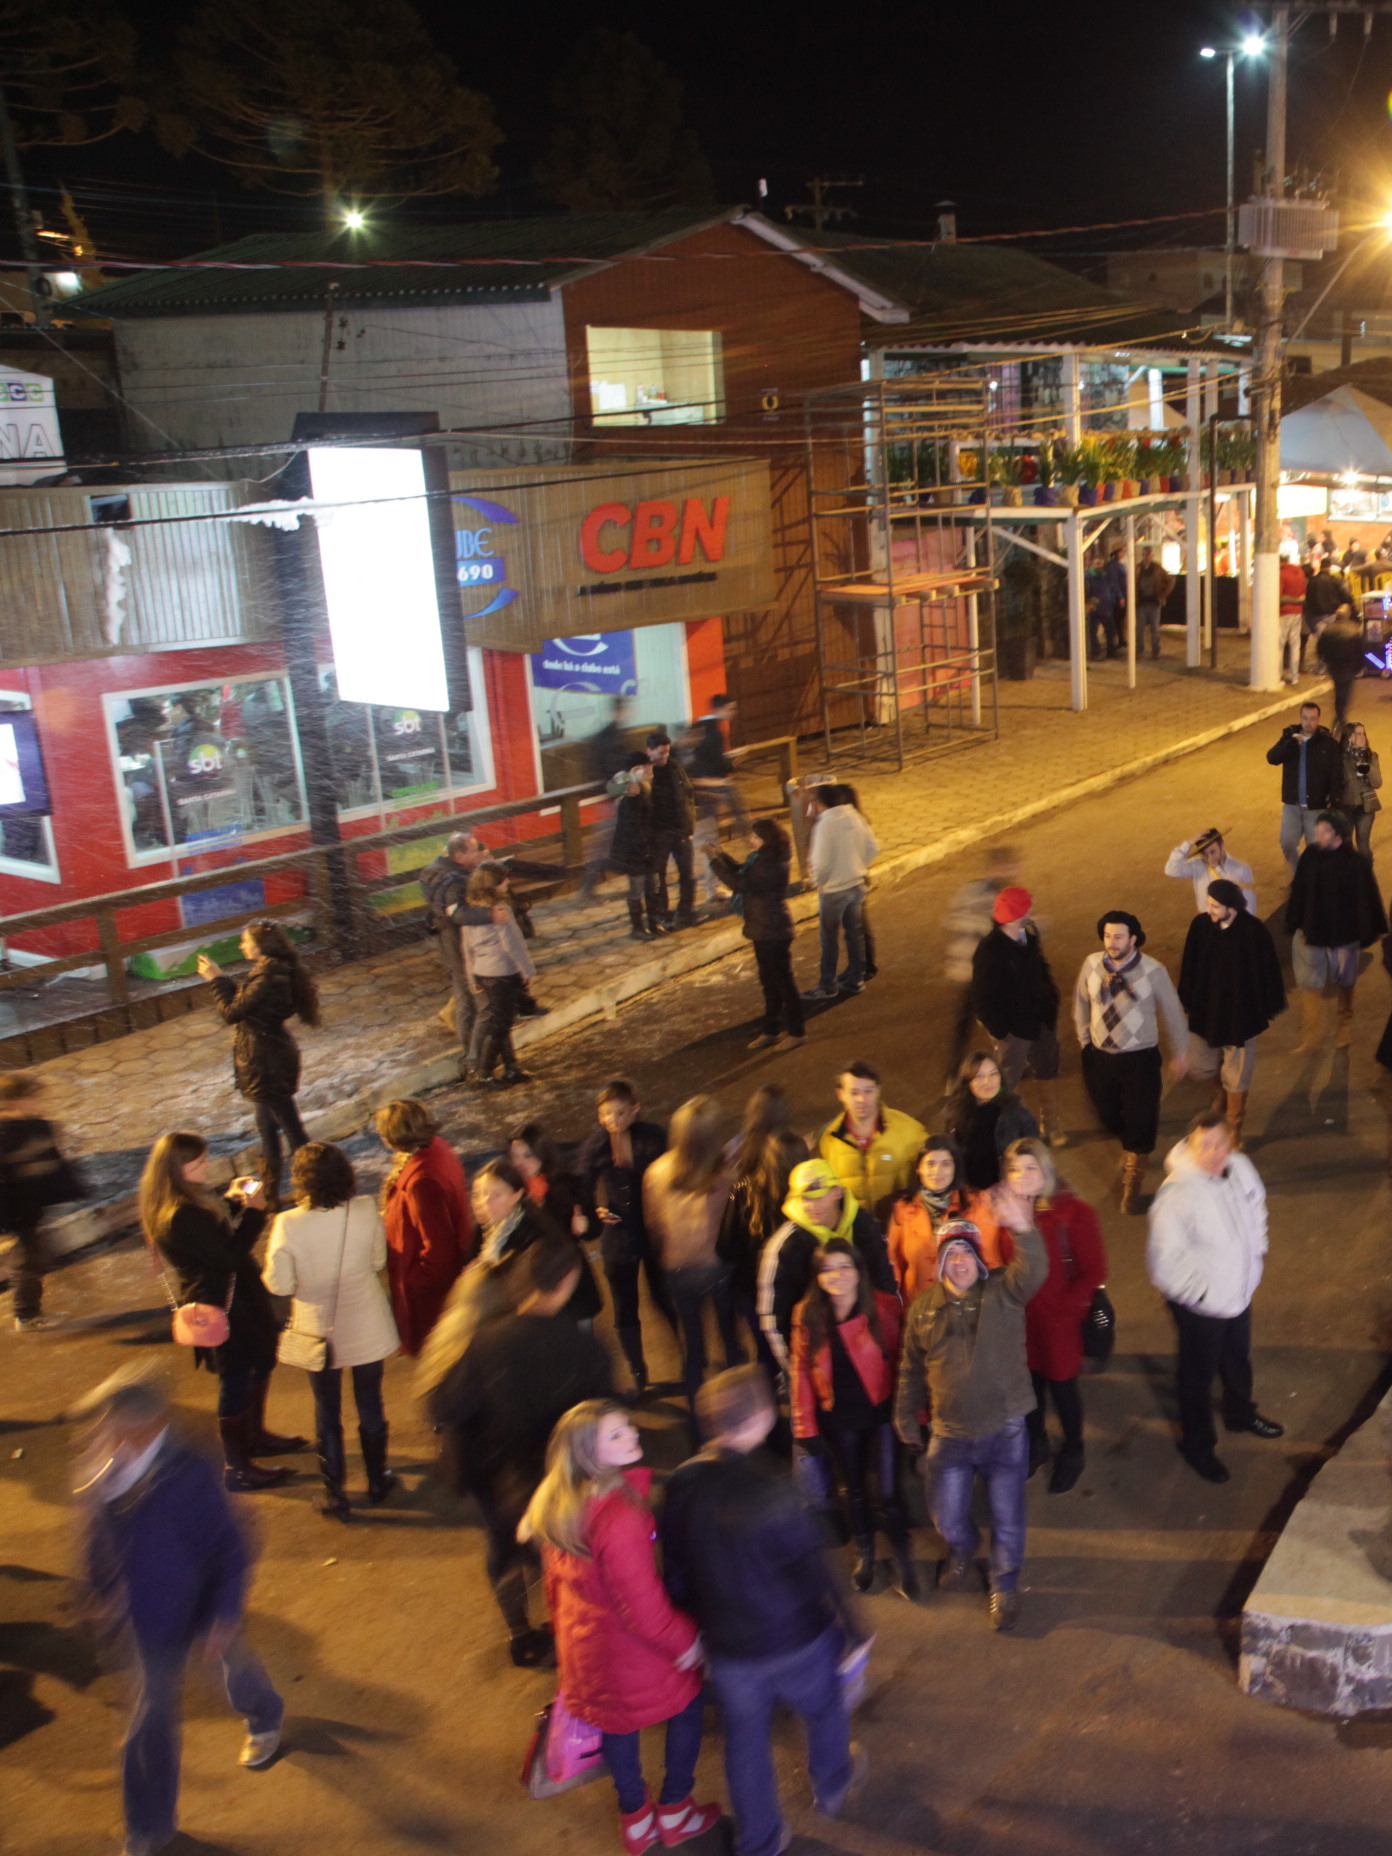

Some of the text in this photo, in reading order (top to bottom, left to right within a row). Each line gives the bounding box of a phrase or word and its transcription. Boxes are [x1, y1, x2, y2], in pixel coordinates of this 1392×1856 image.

[581, 497, 729, 573] CBN
[457, 564, 493, 581] 690
[395, 716, 421, 735] sbt
[188, 752, 222, 773] sbt
